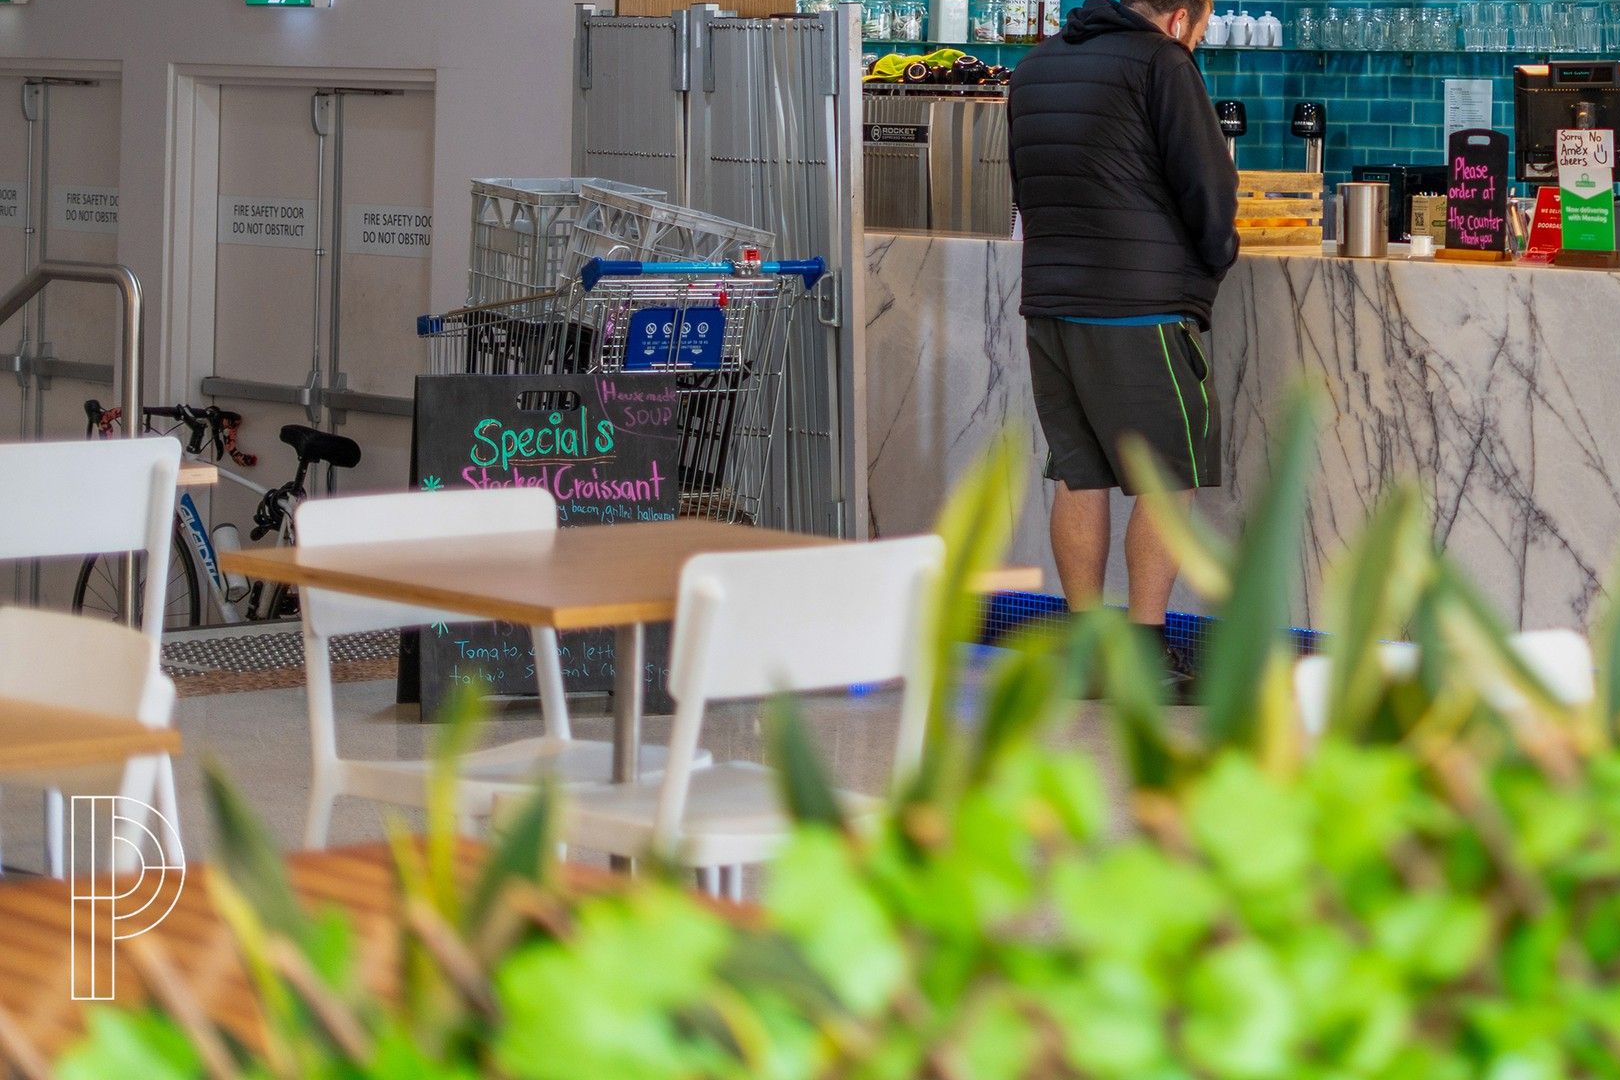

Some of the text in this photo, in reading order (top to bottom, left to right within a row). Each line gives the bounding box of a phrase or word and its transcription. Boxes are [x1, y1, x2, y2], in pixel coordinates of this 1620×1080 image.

[882, 127, 915, 135] ROCKET
[1560, 130, 1602, 148] Sorry No
[1561, 144, 1588, 156] Amex
[1454, 156, 1488, 181] Please
[1560, 157, 1588, 167] cheers
[0, 189, 17, 201] OOR
[1448, 175, 1496, 201] order at
[66, 192, 81, 205] FIRE
[83, 193, 108, 207] SAFETY
[65, 209, 77, 221] DO
[78, 210, 94, 222] NOT
[233, 204, 304, 219] FIRE SAFETY DOOR
[1448, 206, 1465, 231] the
[363, 212, 381, 226] FIRE
[382, 213, 413, 228] SAFETY
[232, 222, 305, 237] DO NOT OBSTRUCT
[362, 230, 377, 244] DO
[378, 231, 396, 245] NOT
[1480, 234, 1493, 250] you
[553, 460, 665, 502] Croissant
